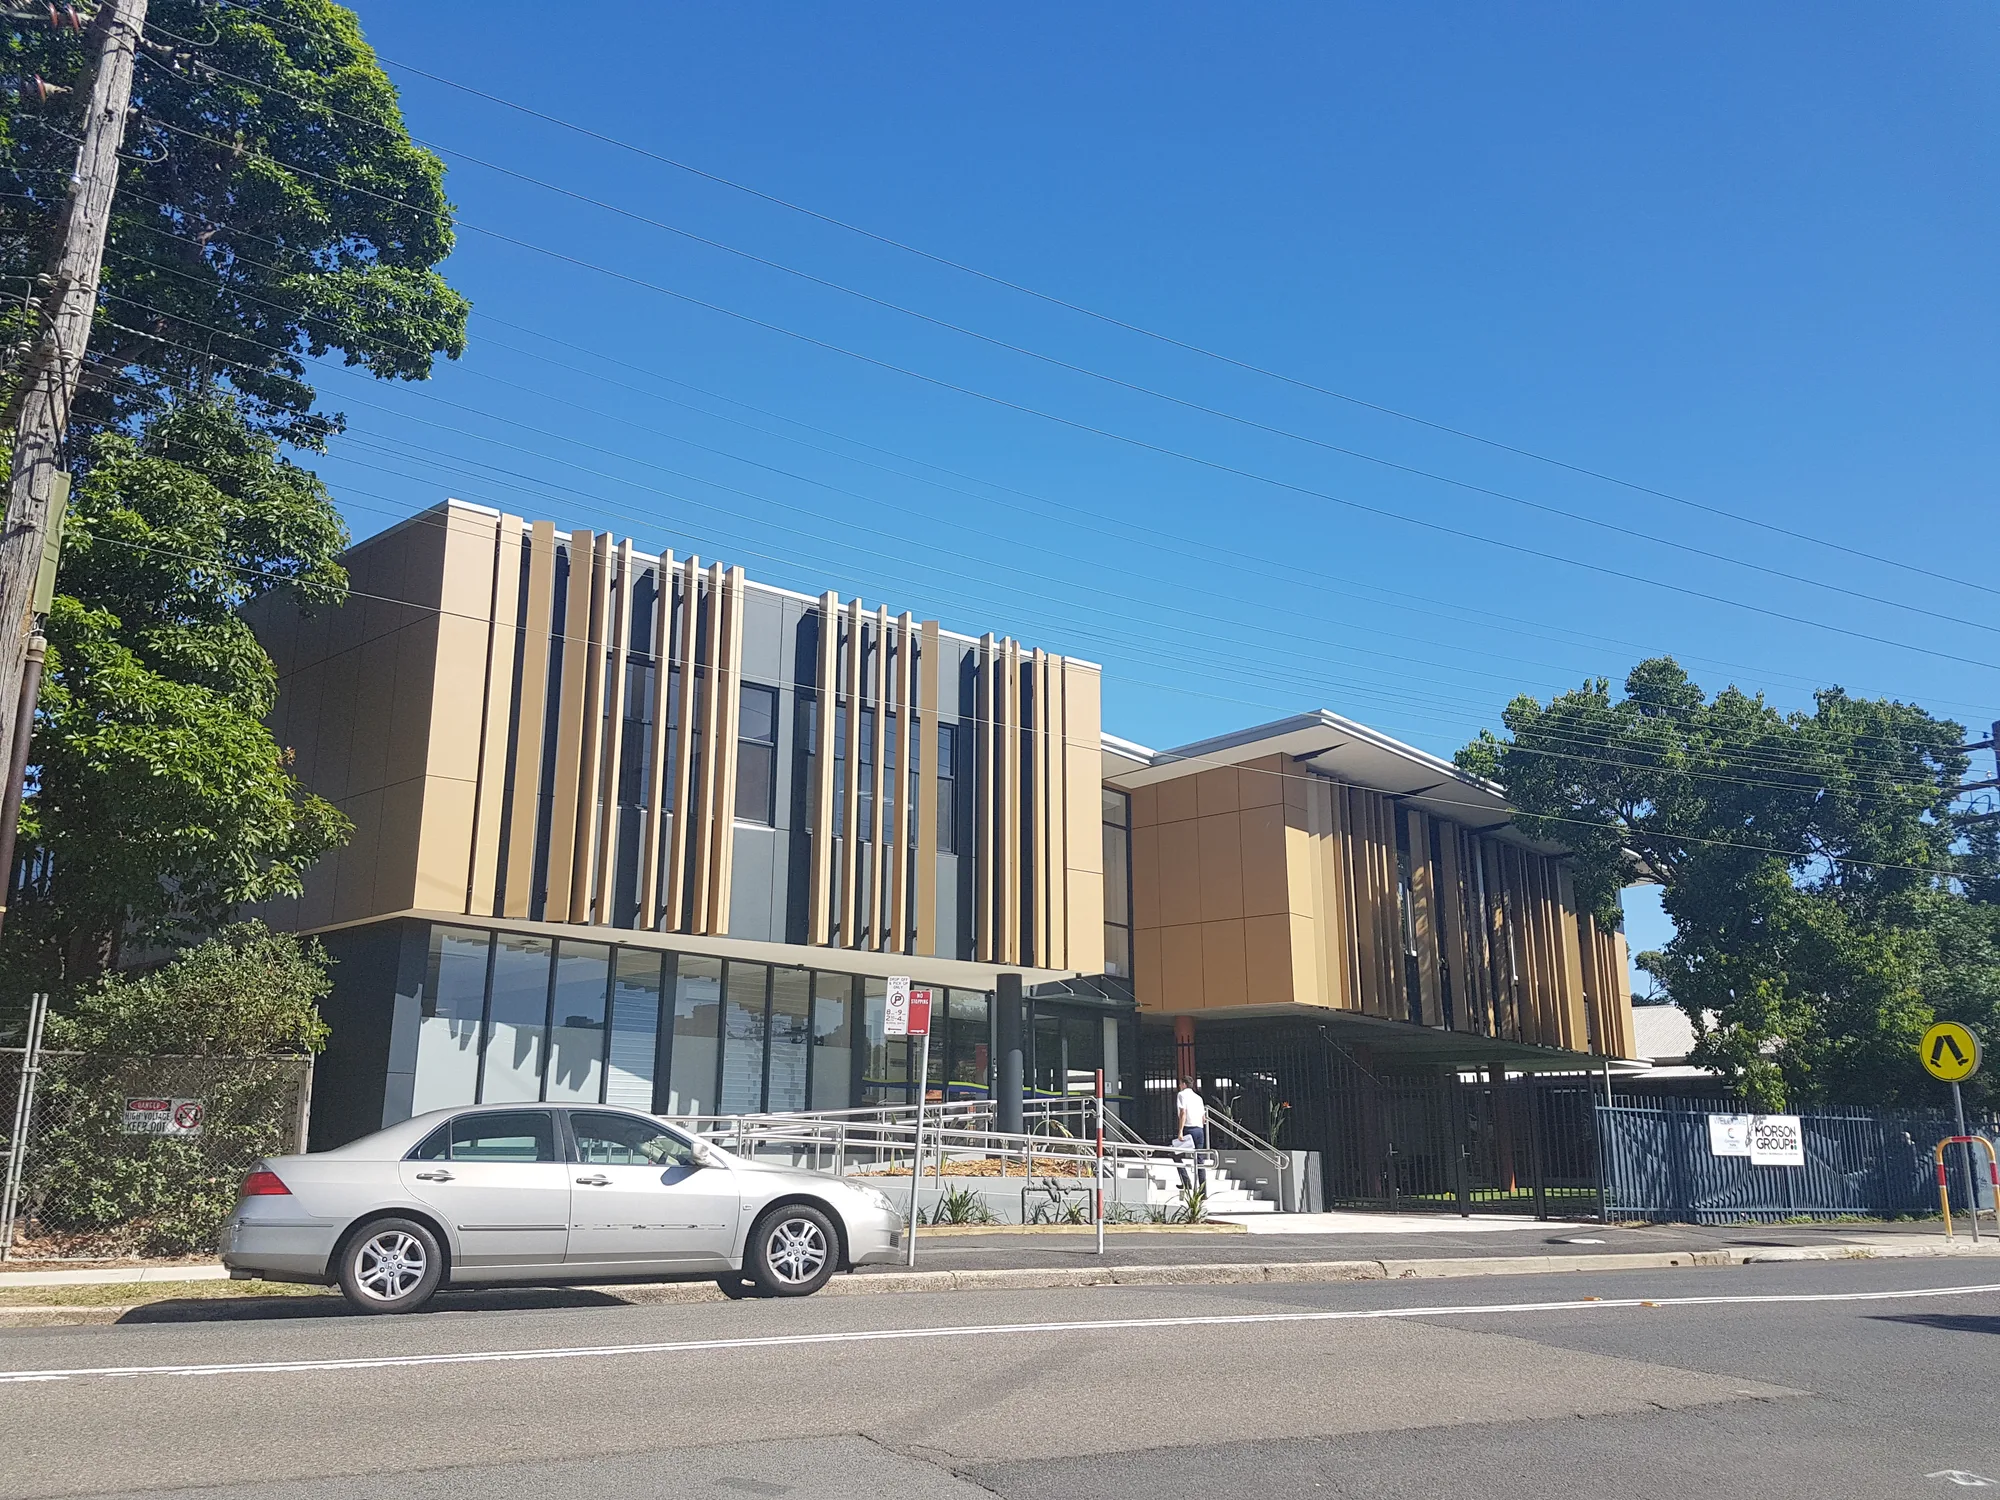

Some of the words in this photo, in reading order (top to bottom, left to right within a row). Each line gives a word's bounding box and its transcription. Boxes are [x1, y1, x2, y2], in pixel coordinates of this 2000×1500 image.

[125, 1112, 141, 1121] HIGH
[143, 1112, 171, 1121] VOLTAGE
[126, 1121, 148, 1132] KEEP
[150, 1121, 167, 1132] OUT
[1755, 1125, 1797, 1138] MORSON
[1756, 1138, 1790, 1150] GROUP
